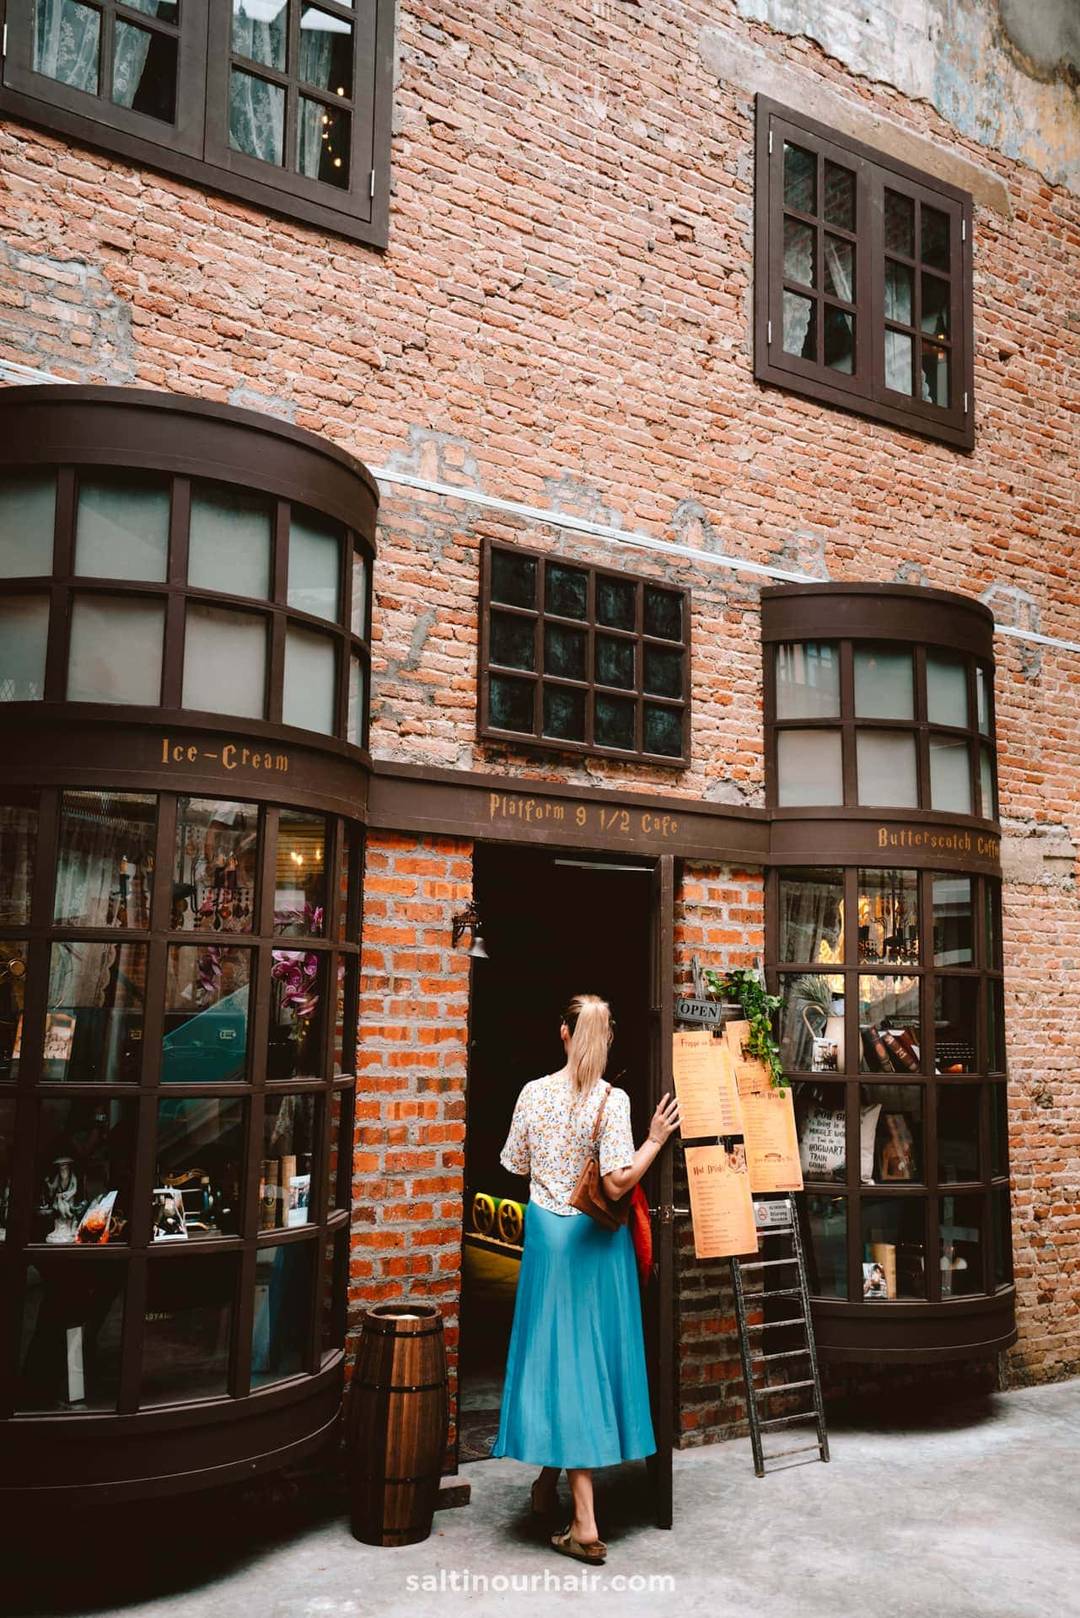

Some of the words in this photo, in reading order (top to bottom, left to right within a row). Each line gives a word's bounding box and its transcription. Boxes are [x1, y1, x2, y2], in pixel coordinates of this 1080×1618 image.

[162, 738, 288, 771] Ice-Cream
[489, 793, 565, 823] Platform
[575, 806, 587, 826] 9
[600, 809, 630, 832] 1/2
[641, 814, 677, 837] Cafe
[878, 827, 971, 851] Butterscotch
[681, 1003, 718, 1017] OPEN
